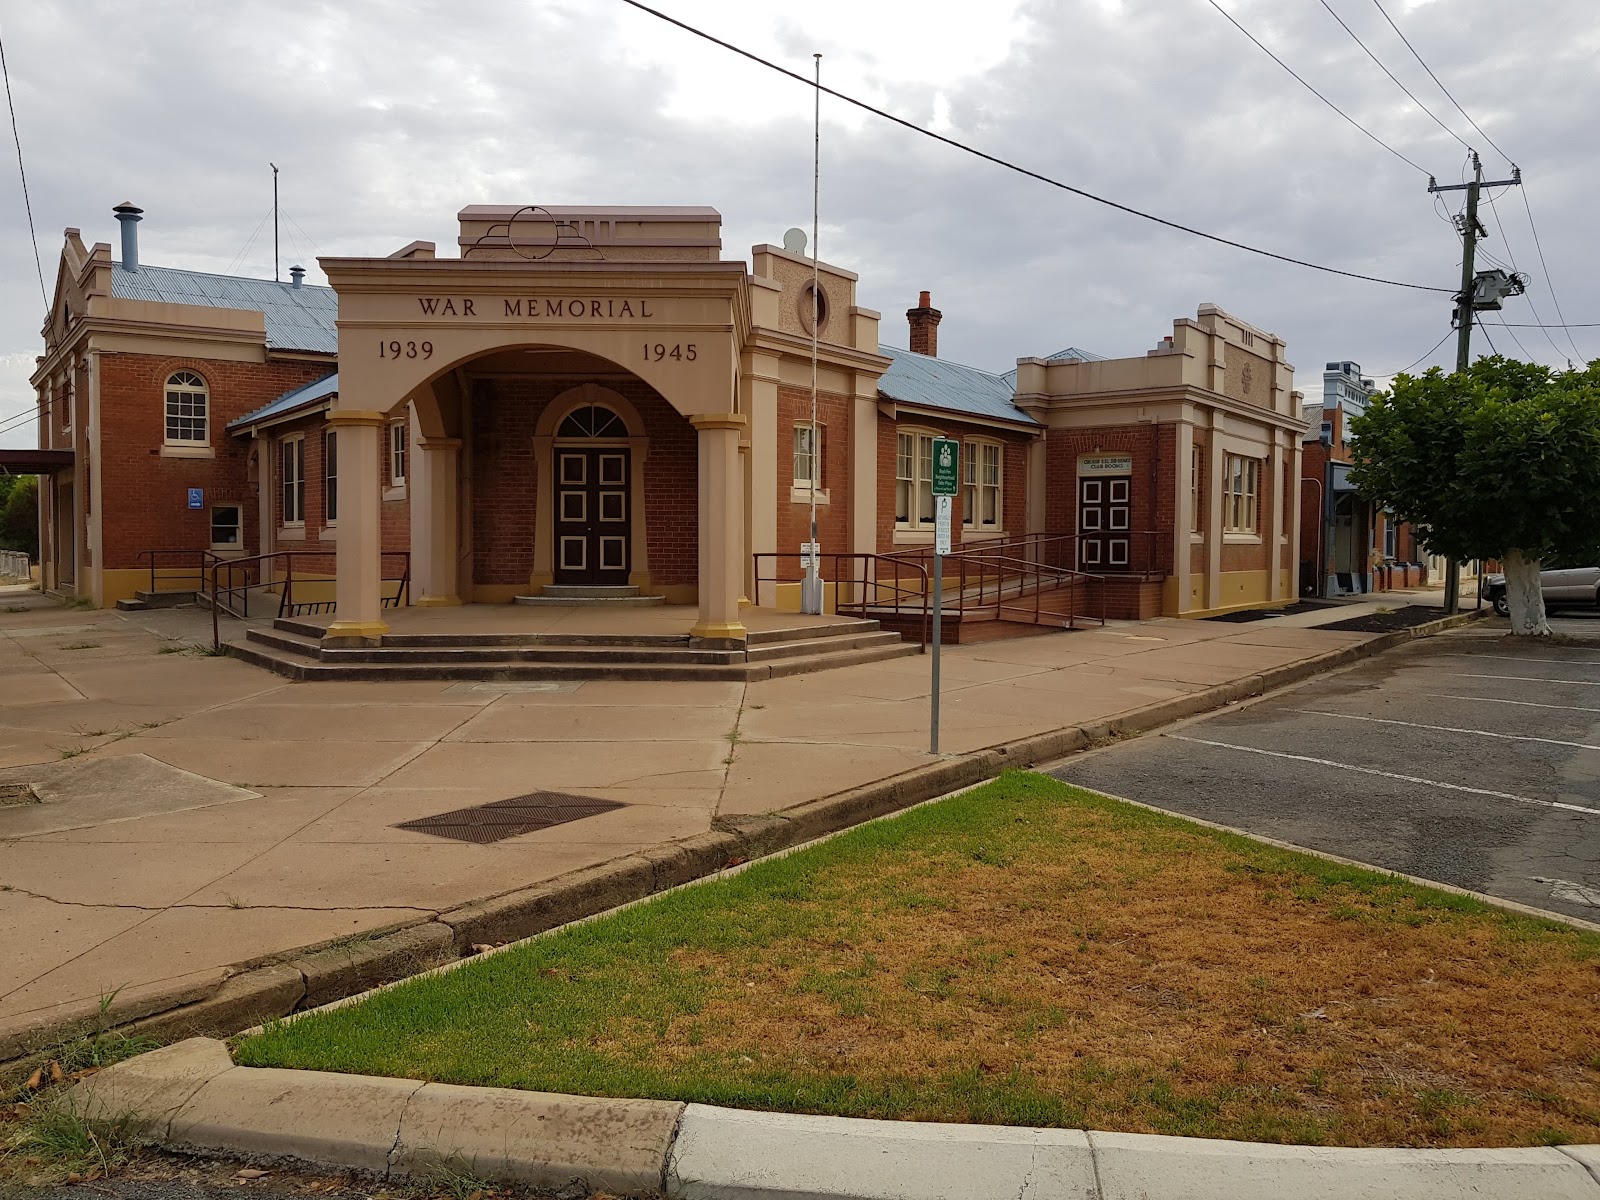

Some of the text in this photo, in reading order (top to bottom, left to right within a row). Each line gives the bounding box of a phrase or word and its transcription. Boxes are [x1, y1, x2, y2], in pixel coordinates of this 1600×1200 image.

[417, 298, 654, 318] WAR MEMORIAL
[379, 341, 434, 360] 1939
[643, 343, 698, 362] 1945
[941, 500, 948, 513] P
